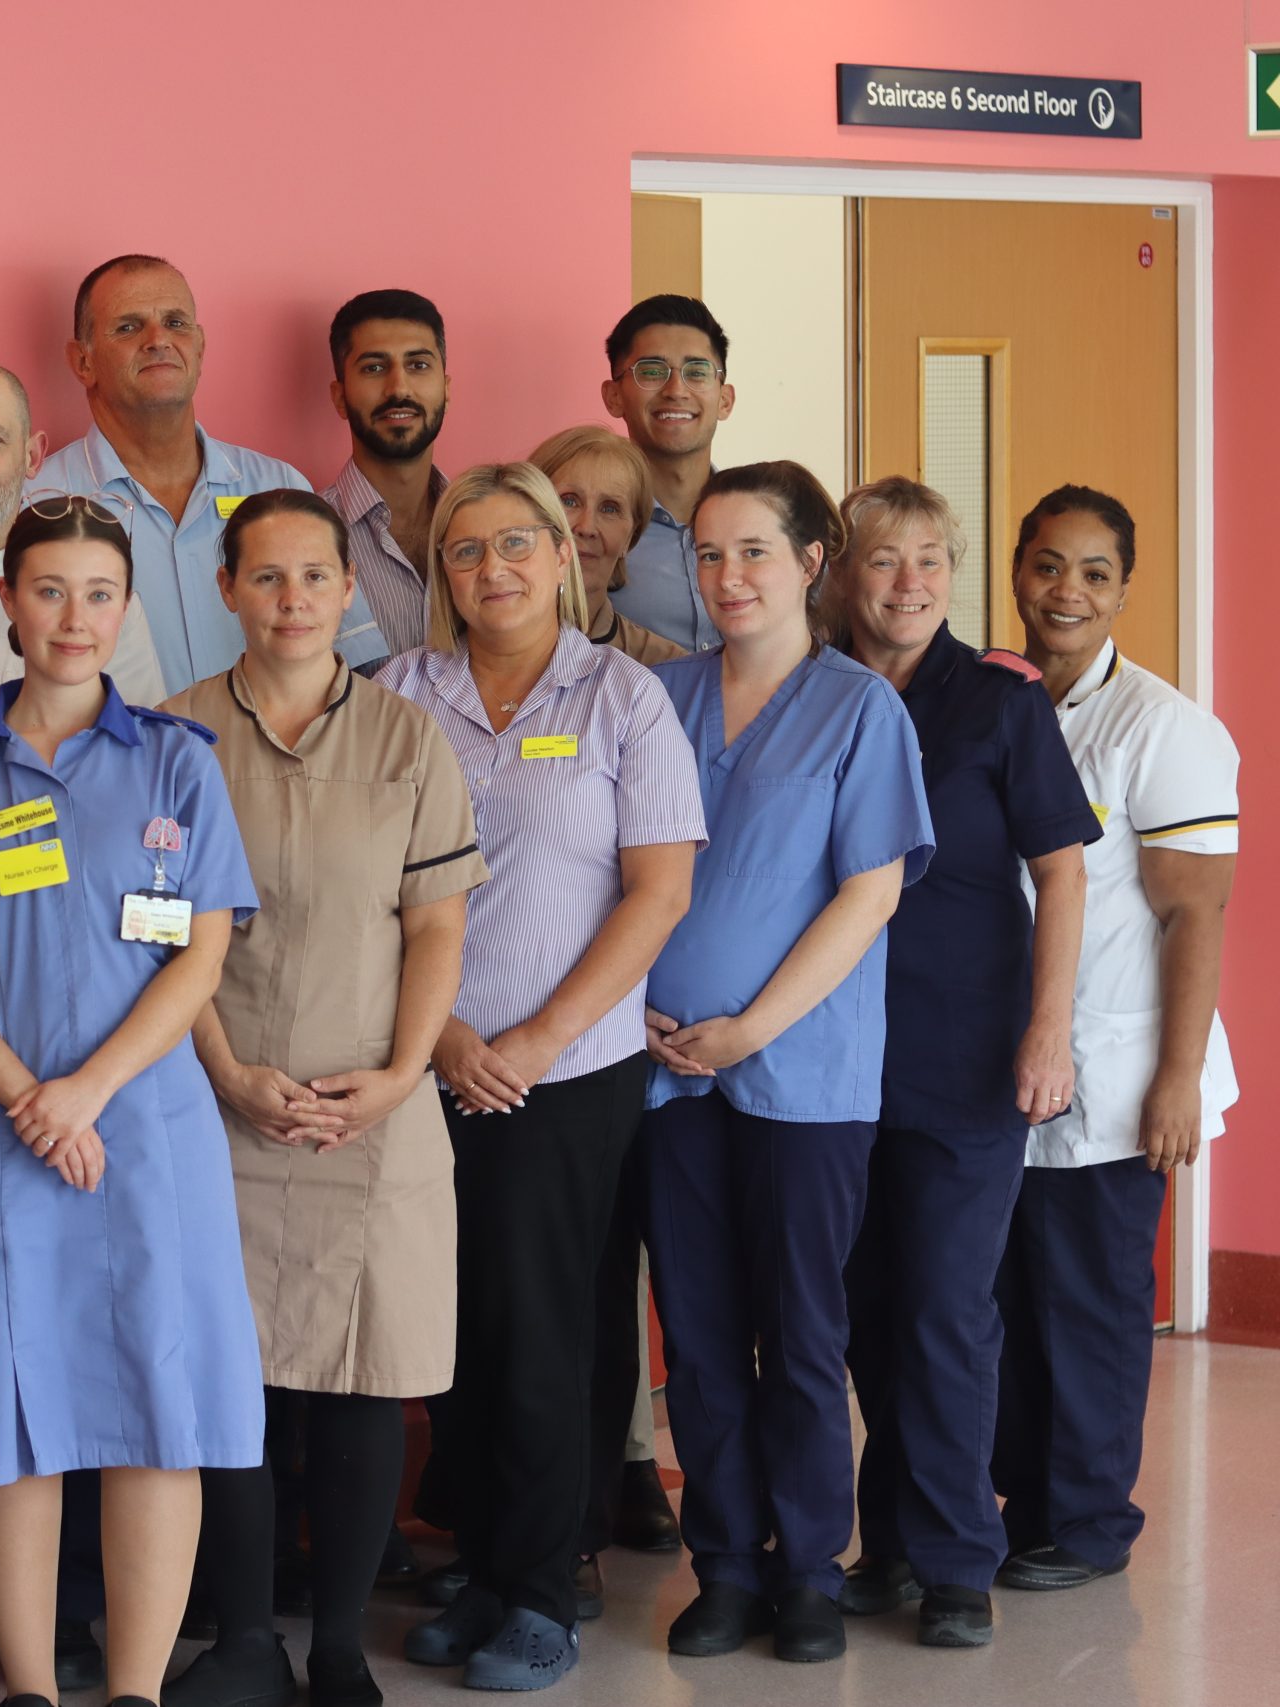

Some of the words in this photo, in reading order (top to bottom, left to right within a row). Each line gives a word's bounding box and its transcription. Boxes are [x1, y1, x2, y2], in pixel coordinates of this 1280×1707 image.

[867, 81, 947, 109] Staircase
[951, 86, 962, 110] 6
[967, 87, 1030, 114] Second
[1034, 91, 1078, 117] Floor
[15, 807, 53, 824] Whitehouse
[4, 871, 25, 880] Nurse
[25, 868, 33, 876] in
[33, 863, 59, 874] Charge
